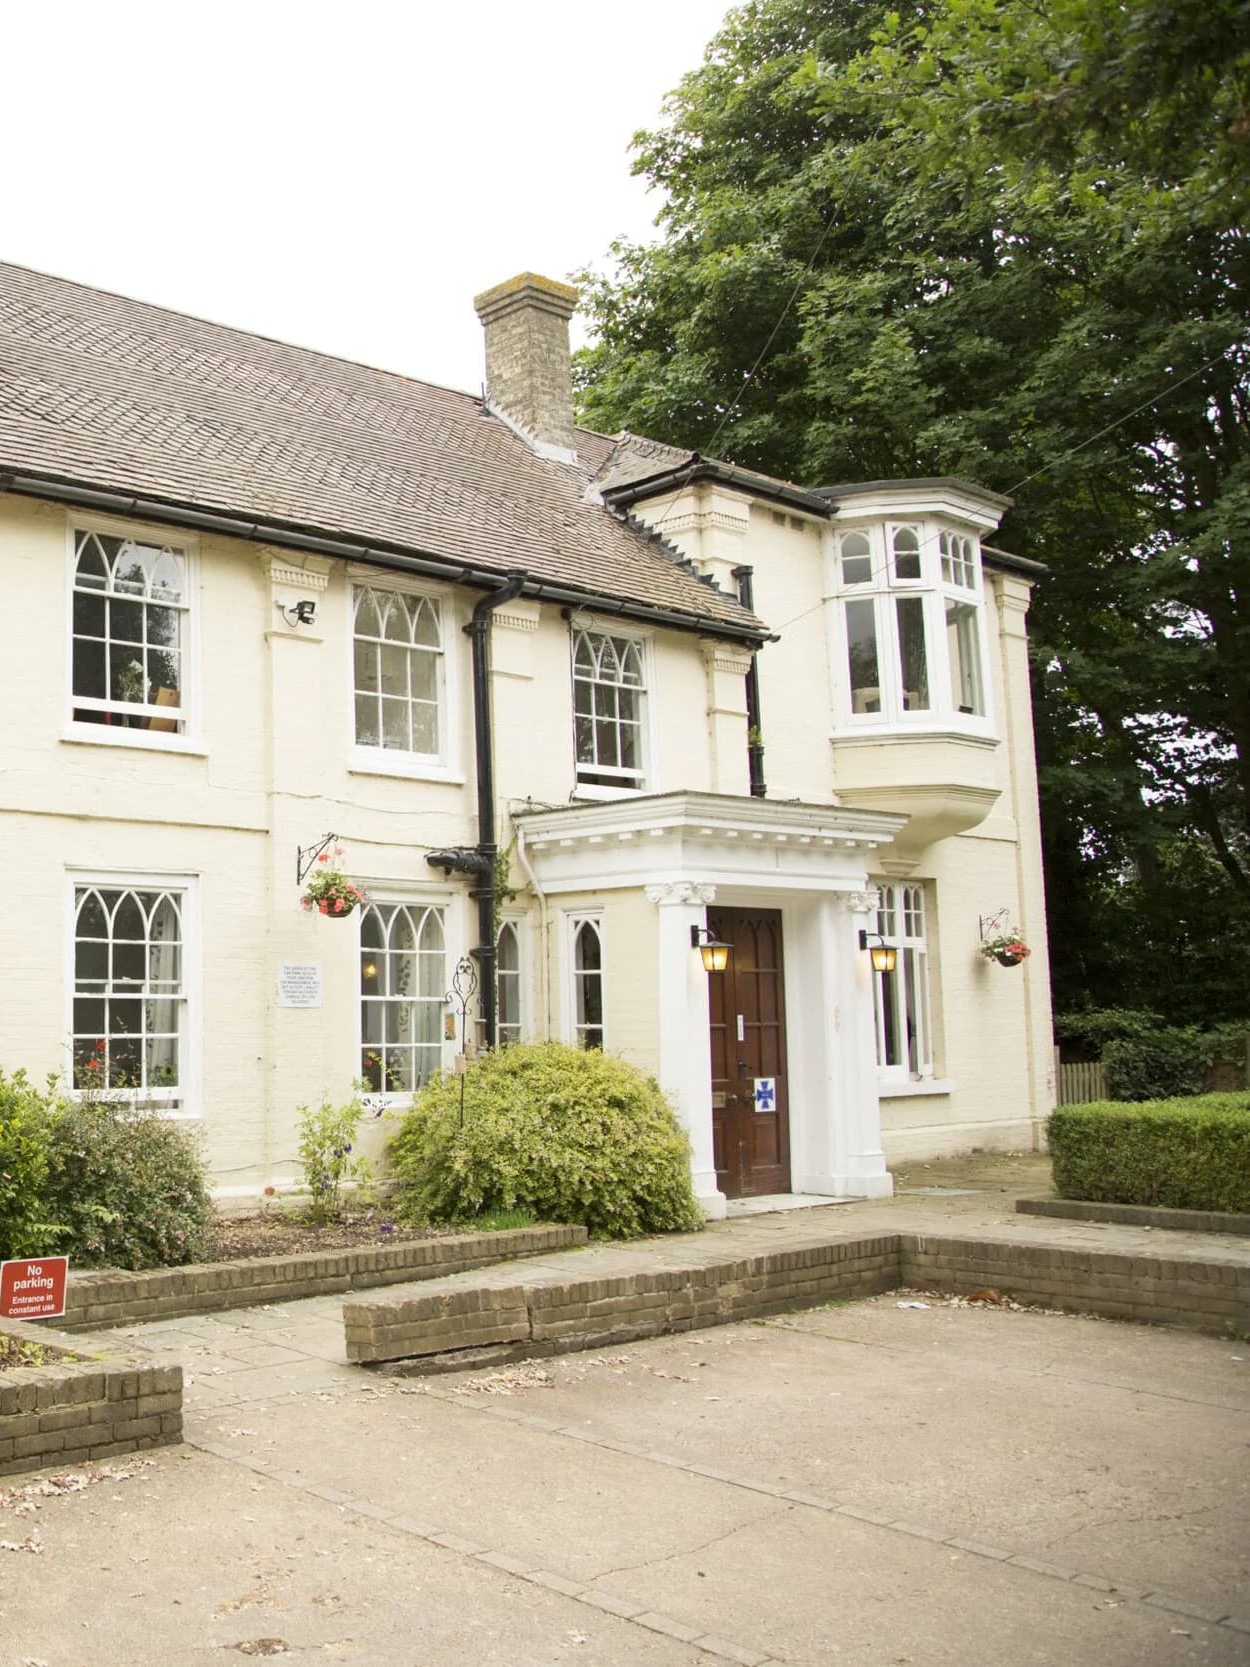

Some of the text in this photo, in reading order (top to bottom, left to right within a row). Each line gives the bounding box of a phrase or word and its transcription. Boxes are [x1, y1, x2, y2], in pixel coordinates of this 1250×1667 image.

[27, 1265, 42, 1276] No
[13, 1277, 54, 1292] parking
[12, 1296, 45, 1304] Entrance
[8, 1305, 41, 1314] constant
